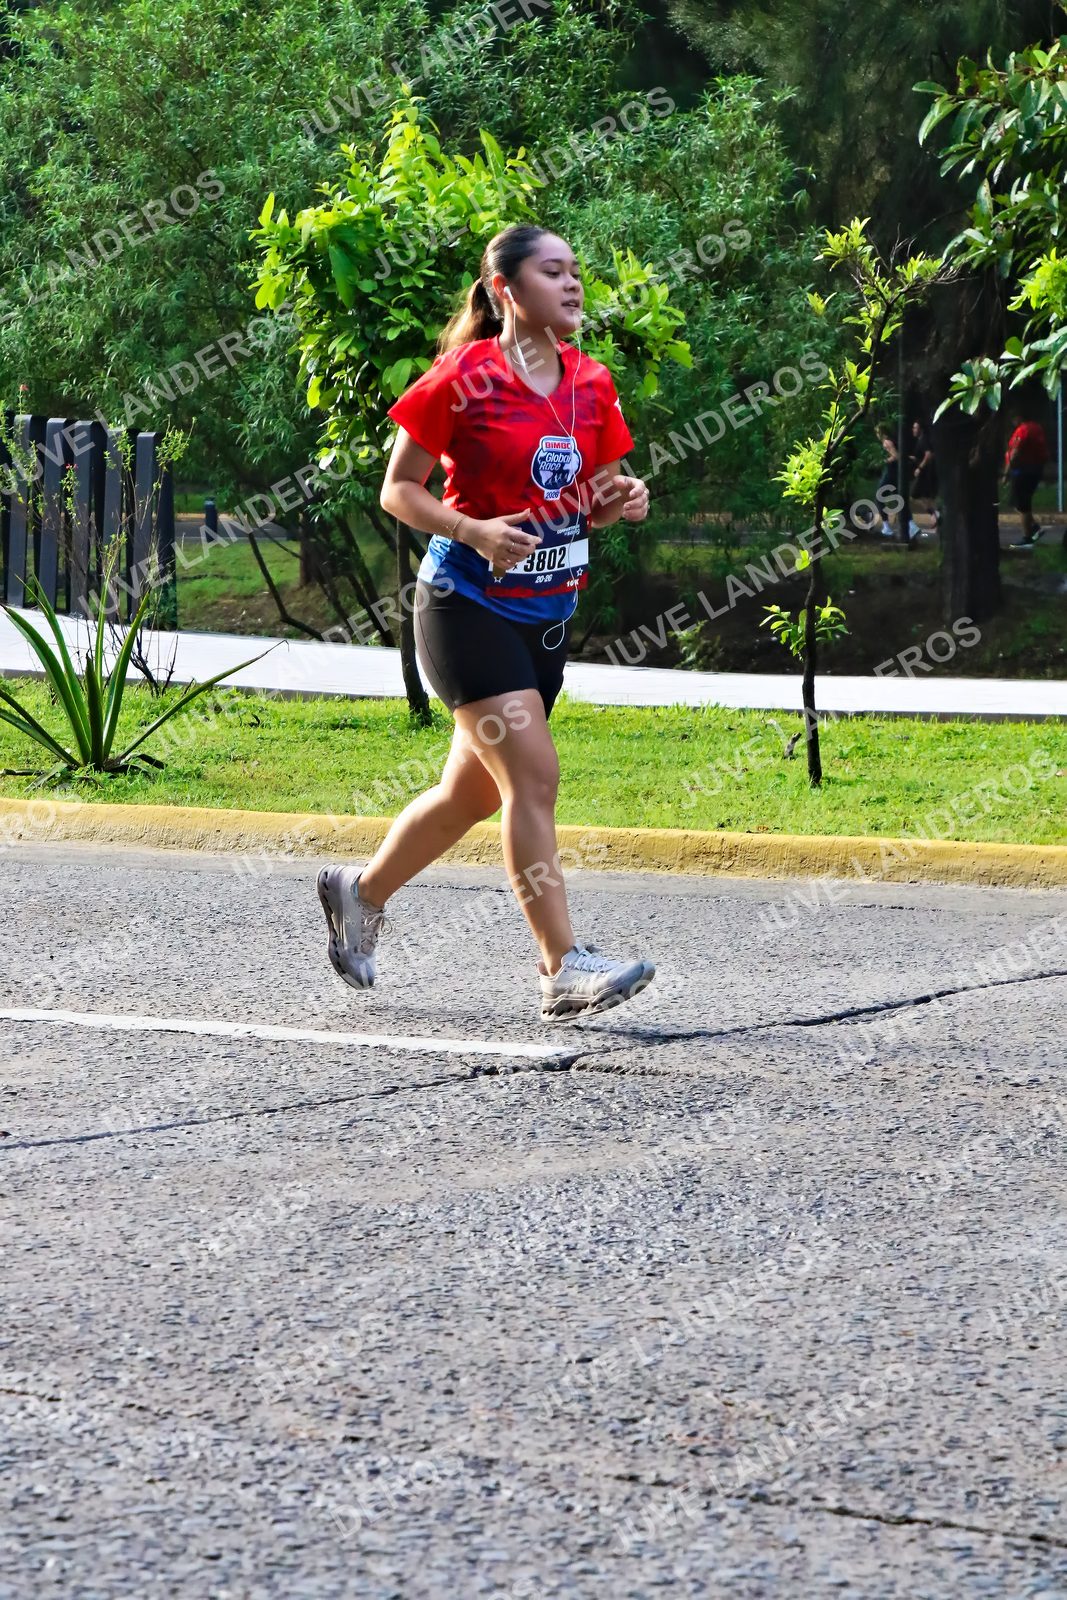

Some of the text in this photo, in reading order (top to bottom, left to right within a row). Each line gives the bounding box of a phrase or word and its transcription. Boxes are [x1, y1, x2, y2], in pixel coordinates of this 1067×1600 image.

[539, 461, 562, 471] Race
[545, 491, 560, 499] 2026
[524, 547, 567, 572] 3802
